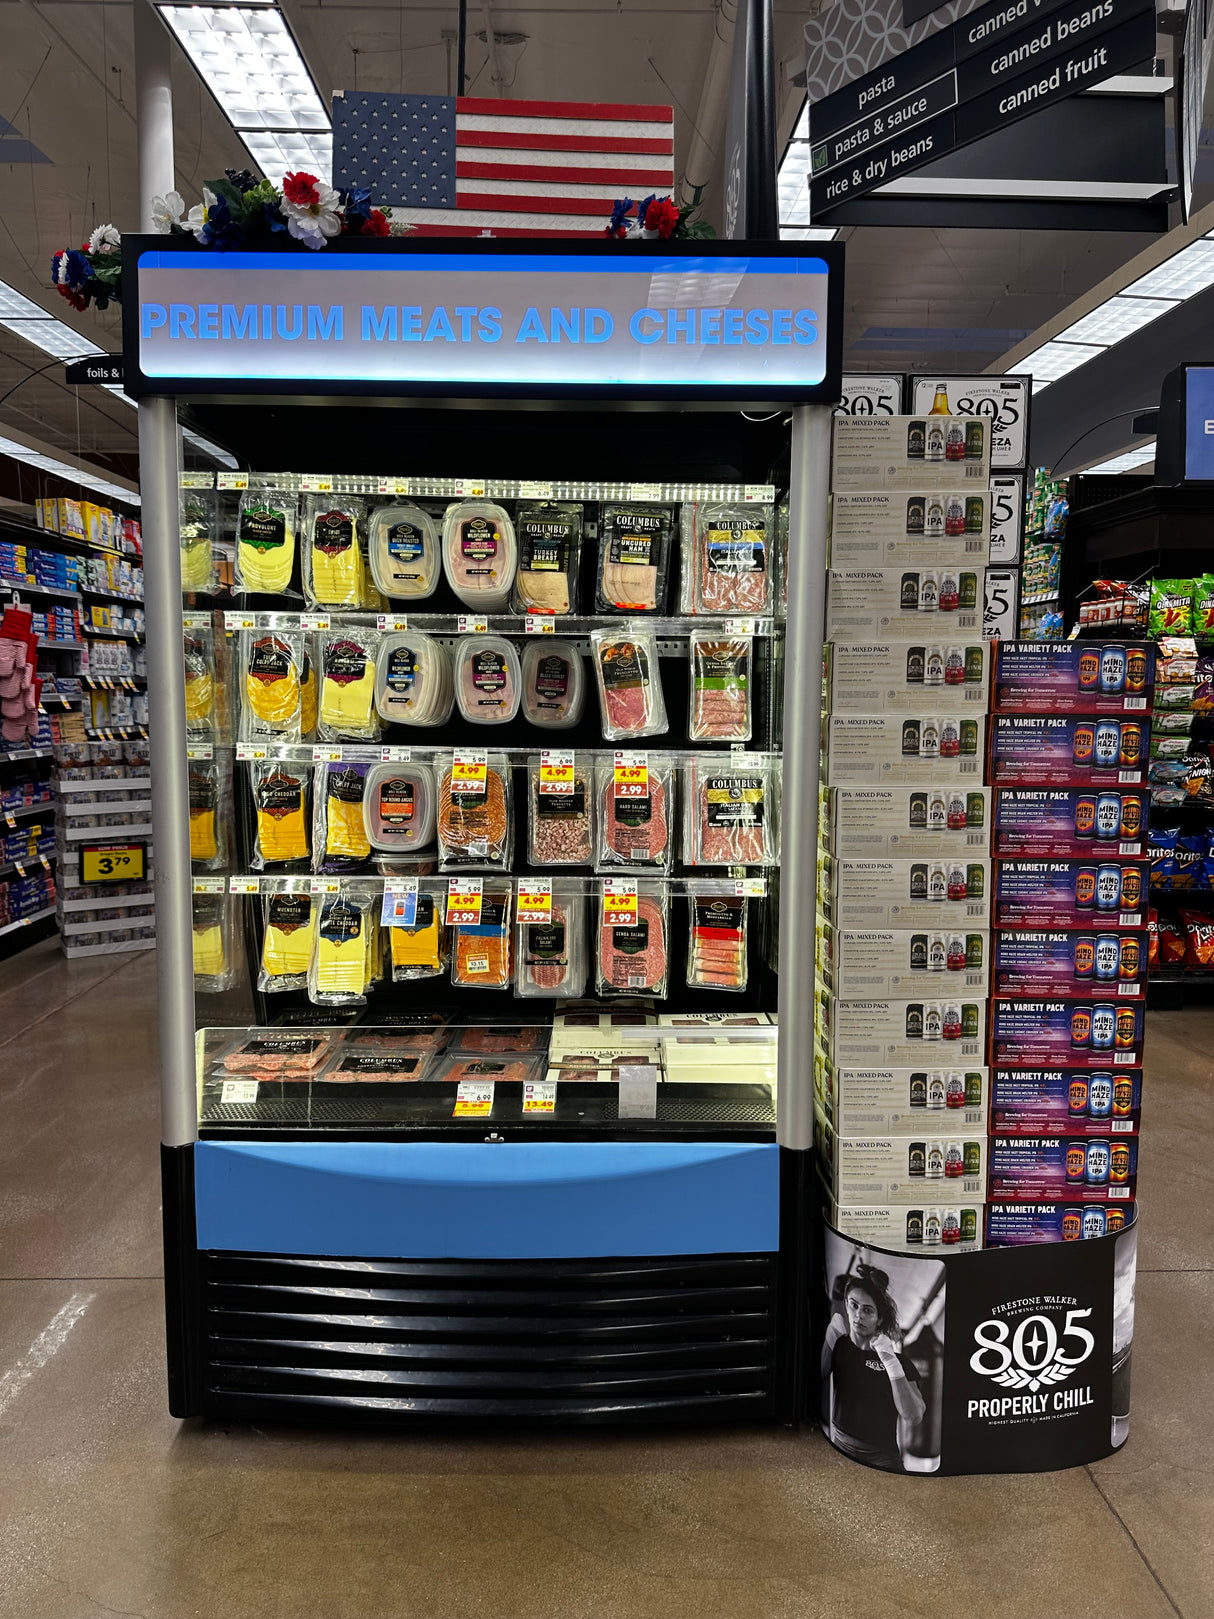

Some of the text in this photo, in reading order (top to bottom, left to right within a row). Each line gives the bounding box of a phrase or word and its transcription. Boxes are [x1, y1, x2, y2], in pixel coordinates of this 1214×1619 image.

[968, 0, 1028, 44] canned
[991, 1, 1114, 76] canned beans
[999, 46, 1108, 116] canned fruit
[858, 74, 896, 109] pasta
[834, 96, 928, 160] pasta & sauce
[826, 134, 934, 200] rice & dry beans
[141, 303, 818, 346] PREMIUM MEATS AND CHEESES
[86, 366, 120, 378] foils &
[1204, 420, 1214, 434] E
[928, 442, 942, 450] IPA
[616, 515, 660, 527] COLUMBUS
[717, 521, 756, 530] COLUMBUS
[526, 524, 569, 534] COLUMBUS
[1004, 644, 1072, 653] IPA VARIETY PACK
[1103, 658, 1123, 666] MIND
[457, 781, 479, 789] 2.99
[546, 783, 567, 791] 2.99
[712, 779, 758, 788] COLUMBUS
[620, 786, 642, 794] 2.99
[1002, 791, 1069, 800] IPA VARIETY PACK
[452, 913, 474, 921] 2.99
[523, 912, 544, 920] 2.99
[610, 914, 631, 922] 2.99
[1001, 933, 1068, 942] IPA VARIETY PACK
[930, 953, 944, 961] IPA
[992, 1205, 1056, 1214] IPA VARIETY PACK
[992, 1296, 1077, 1315] FIRESTONE WALKER
[1007, 1306, 1034, 1316] BREWING
[970, 1308, 1094, 1375] 805
[968, 1386, 1094, 1418] PROPERLY CHILL
[1057, 1411, 1079, 1419] CALIFORNIA
